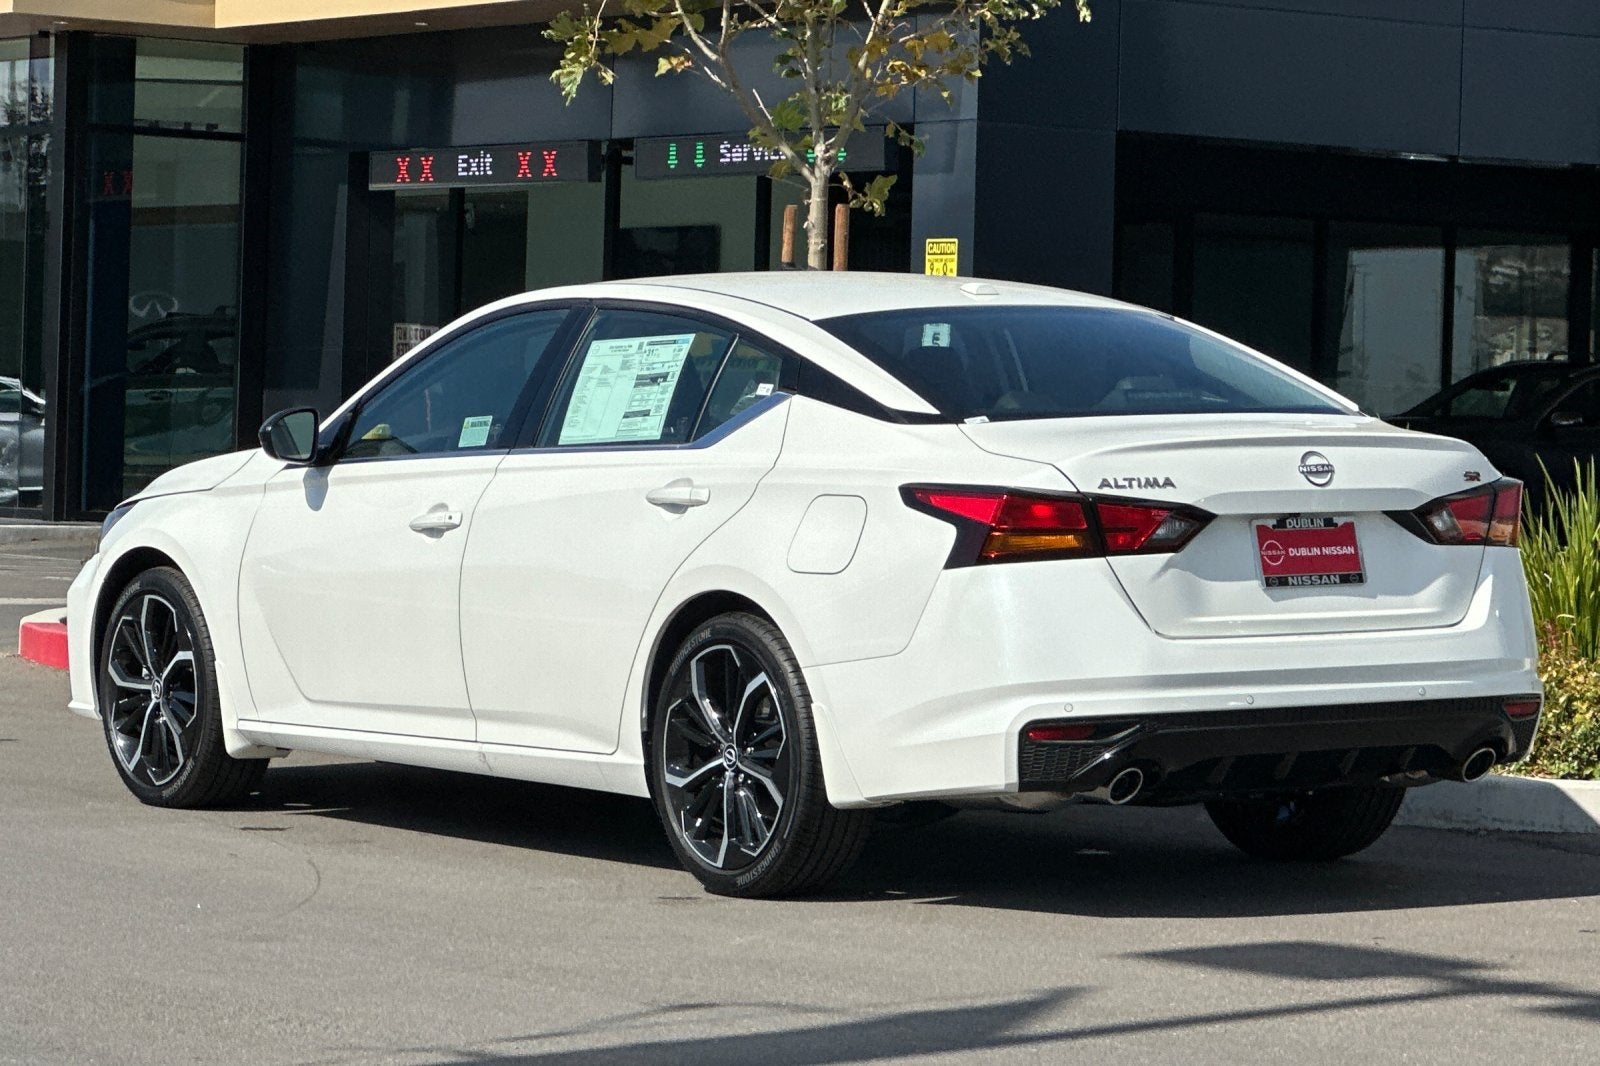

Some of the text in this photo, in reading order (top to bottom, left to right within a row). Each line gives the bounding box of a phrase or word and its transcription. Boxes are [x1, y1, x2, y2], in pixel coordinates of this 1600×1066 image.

[458, 150, 493, 176] Exit
[928, 243, 956, 254] CAUTION
[1299, 464, 1333, 472] NISSAN
[1097, 476, 1177, 490] ALTIMA
[1285, 518, 1325, 528] DUBLIN
[1288, 545, 1355, 556] DUBLIN NISSAN
[1288, 574, 1341, 586] NISSAN
